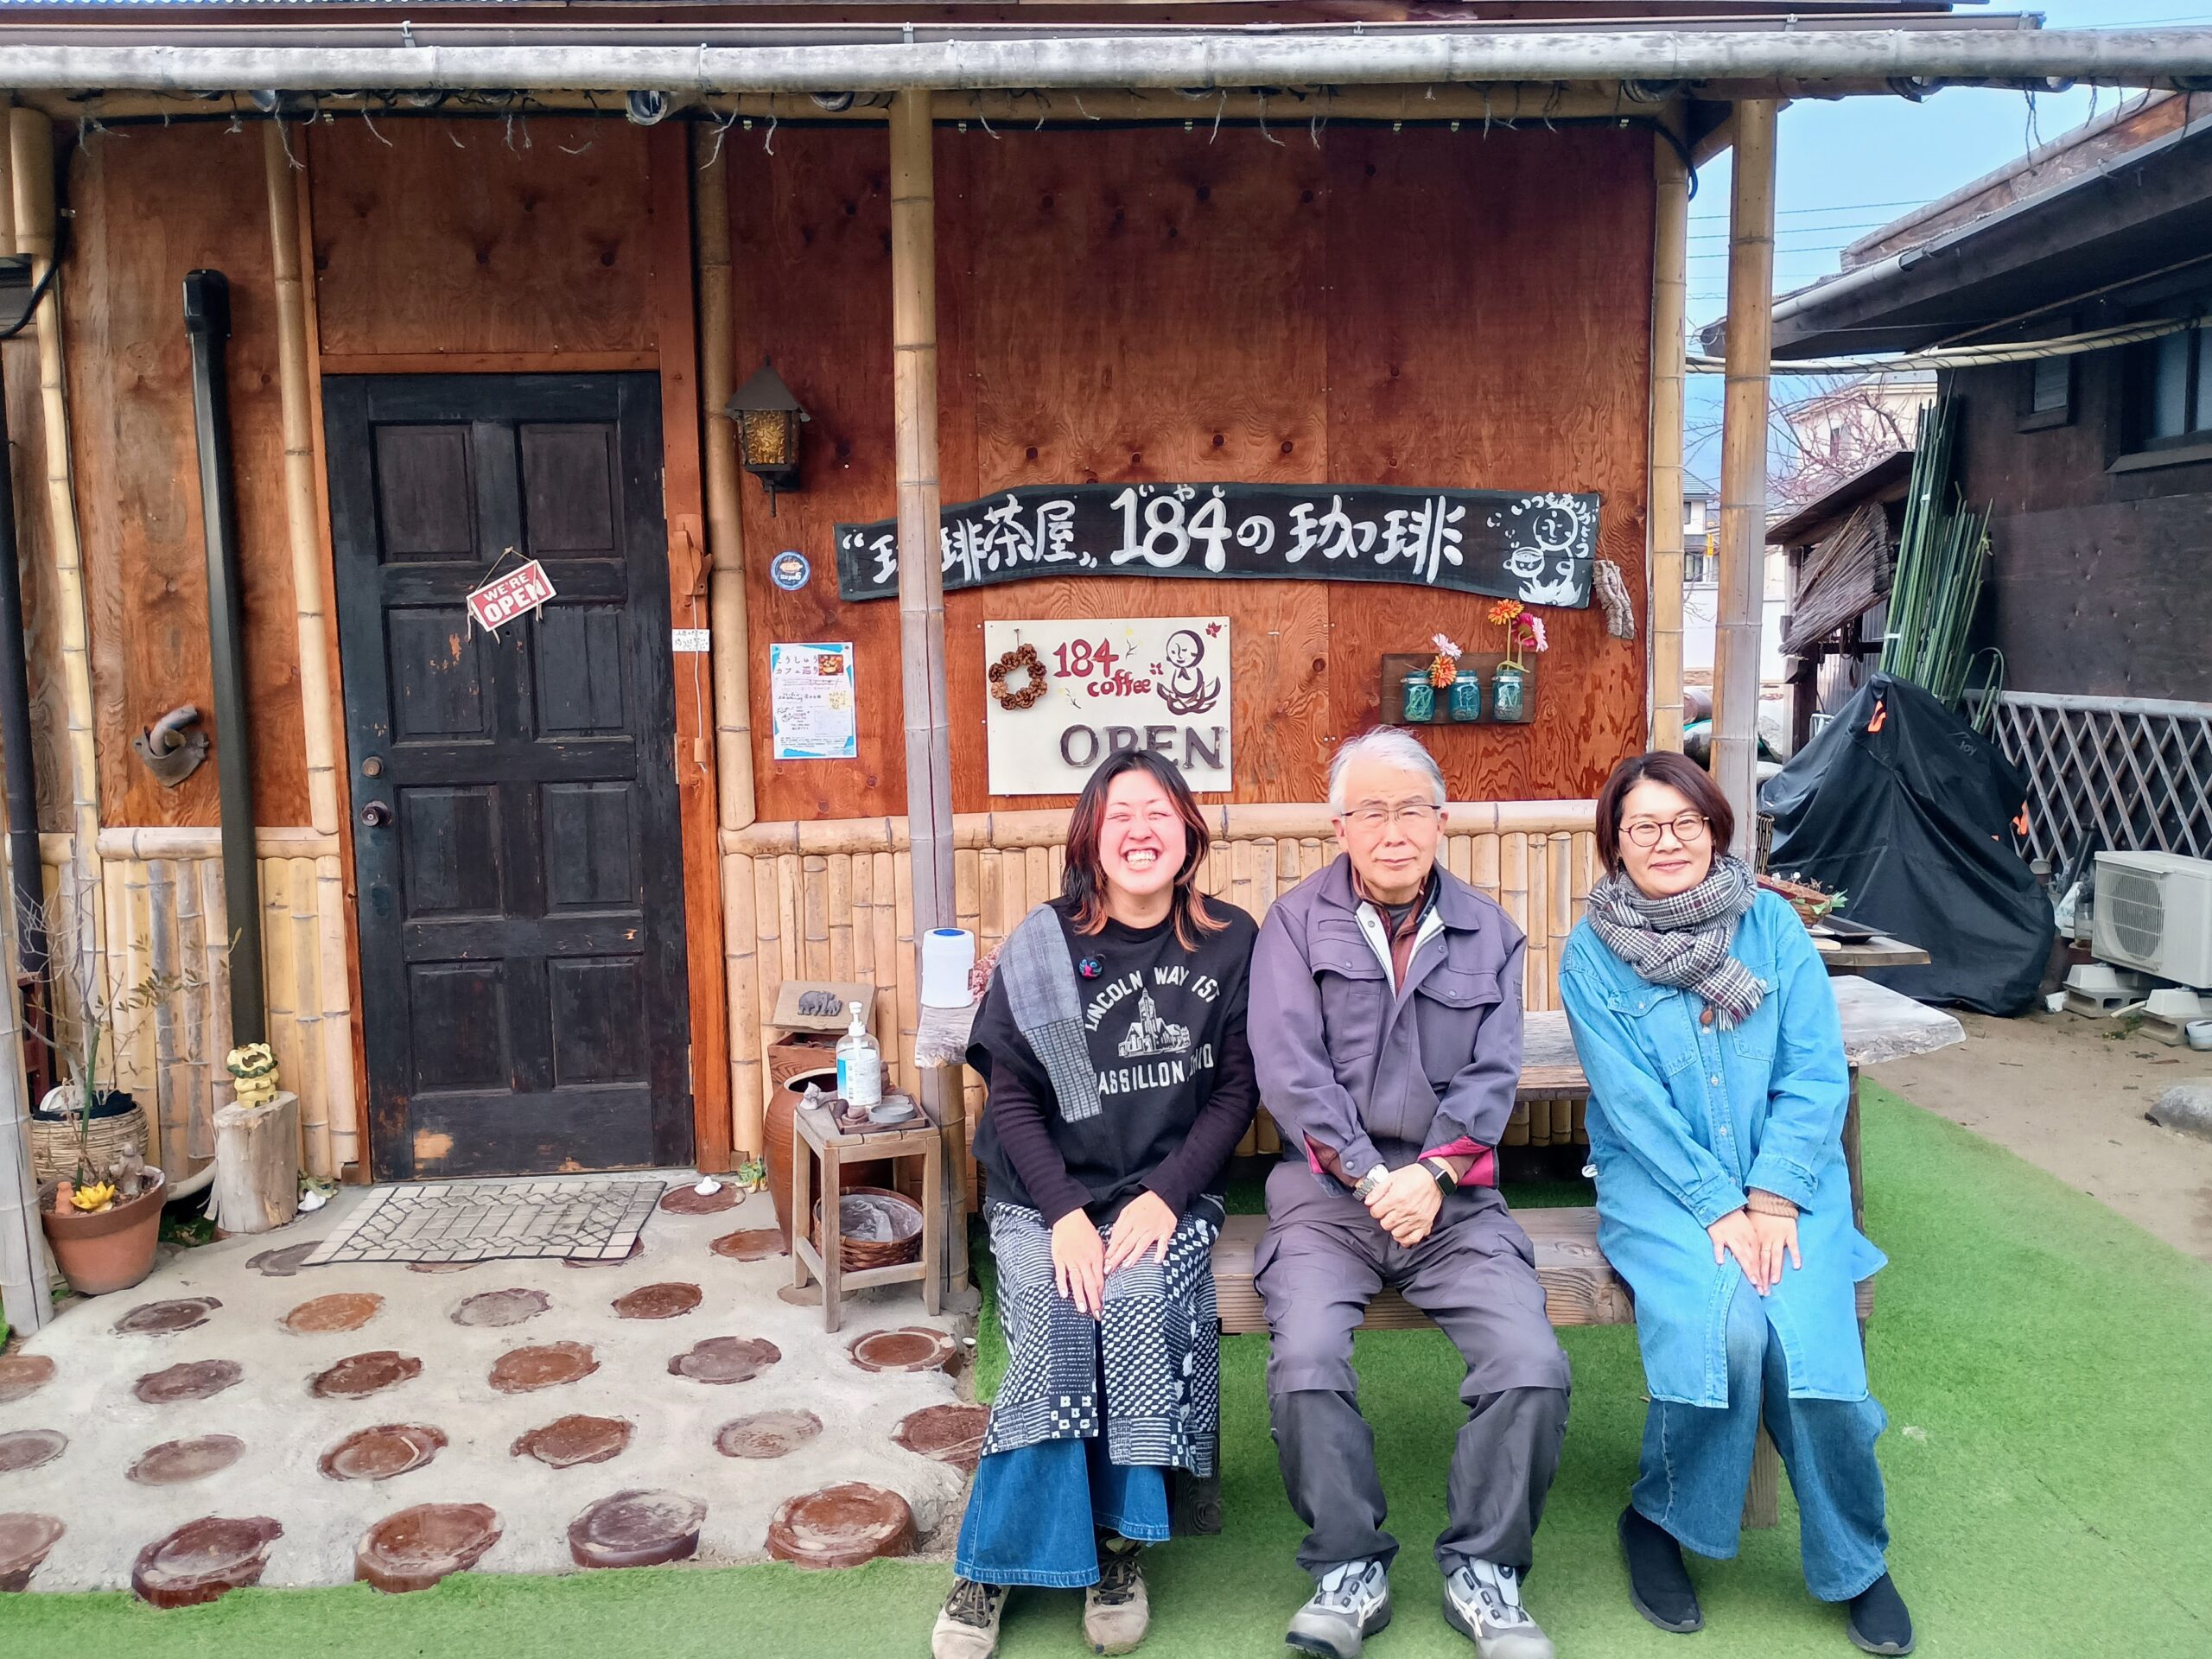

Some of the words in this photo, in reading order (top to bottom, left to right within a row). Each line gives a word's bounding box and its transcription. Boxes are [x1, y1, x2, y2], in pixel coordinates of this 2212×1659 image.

[483, 572, 530, 602] WE'RE
[483, 579, 546, 623] OPEN
[1052, 638, 1119, 678] 184
[1087, 669, 1152, 697] coffee
[1085, 969, 1144, 1033] LINCOLN
[1154, 966, 1190, 987] WAY
[1095, 1060, 1190, 1096] ASSILLON,
